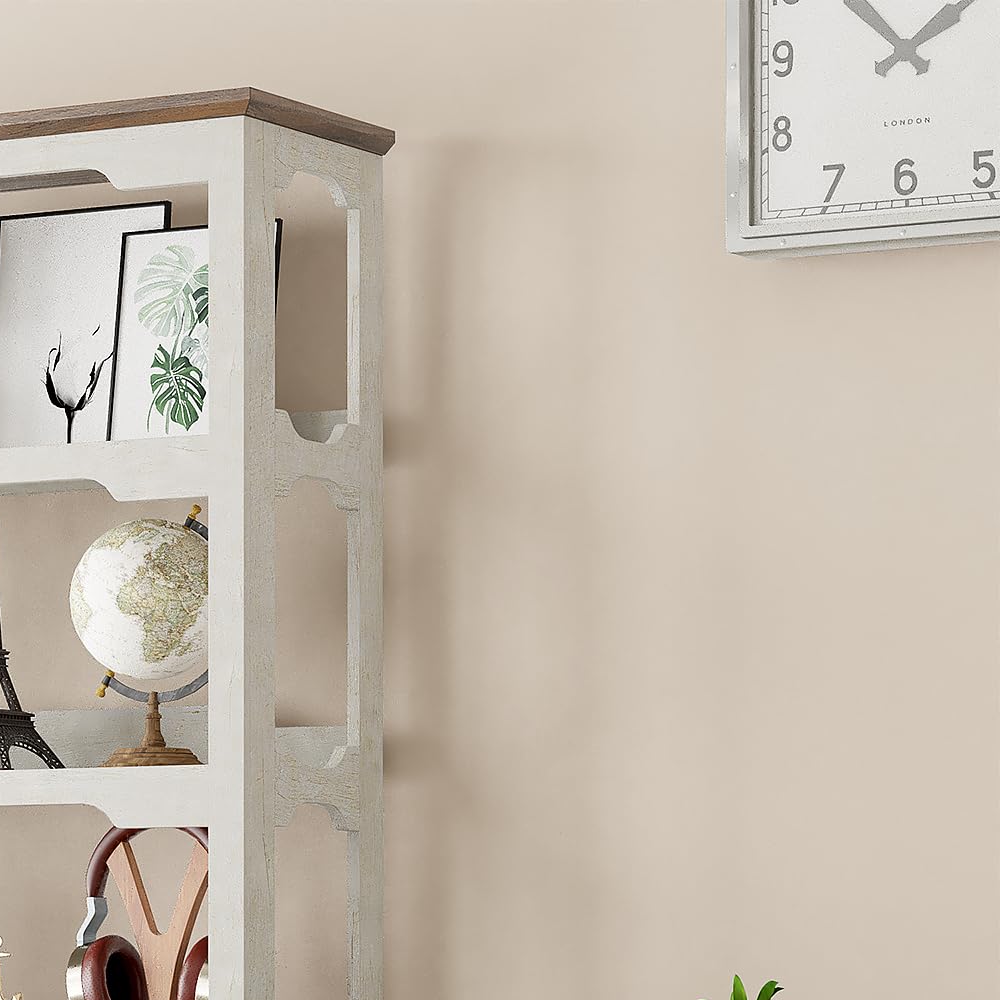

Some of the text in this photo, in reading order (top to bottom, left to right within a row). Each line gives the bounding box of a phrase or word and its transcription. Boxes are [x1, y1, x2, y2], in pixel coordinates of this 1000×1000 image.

[772, 40, 794, 78] 9
[772, 115, 793, 152] 8
[883, 117, 931, 128] LONDON
[822, 163, 846, 203] 7
[893, 158, 918, 196] 6
[972, 150, 996, 189] 5
